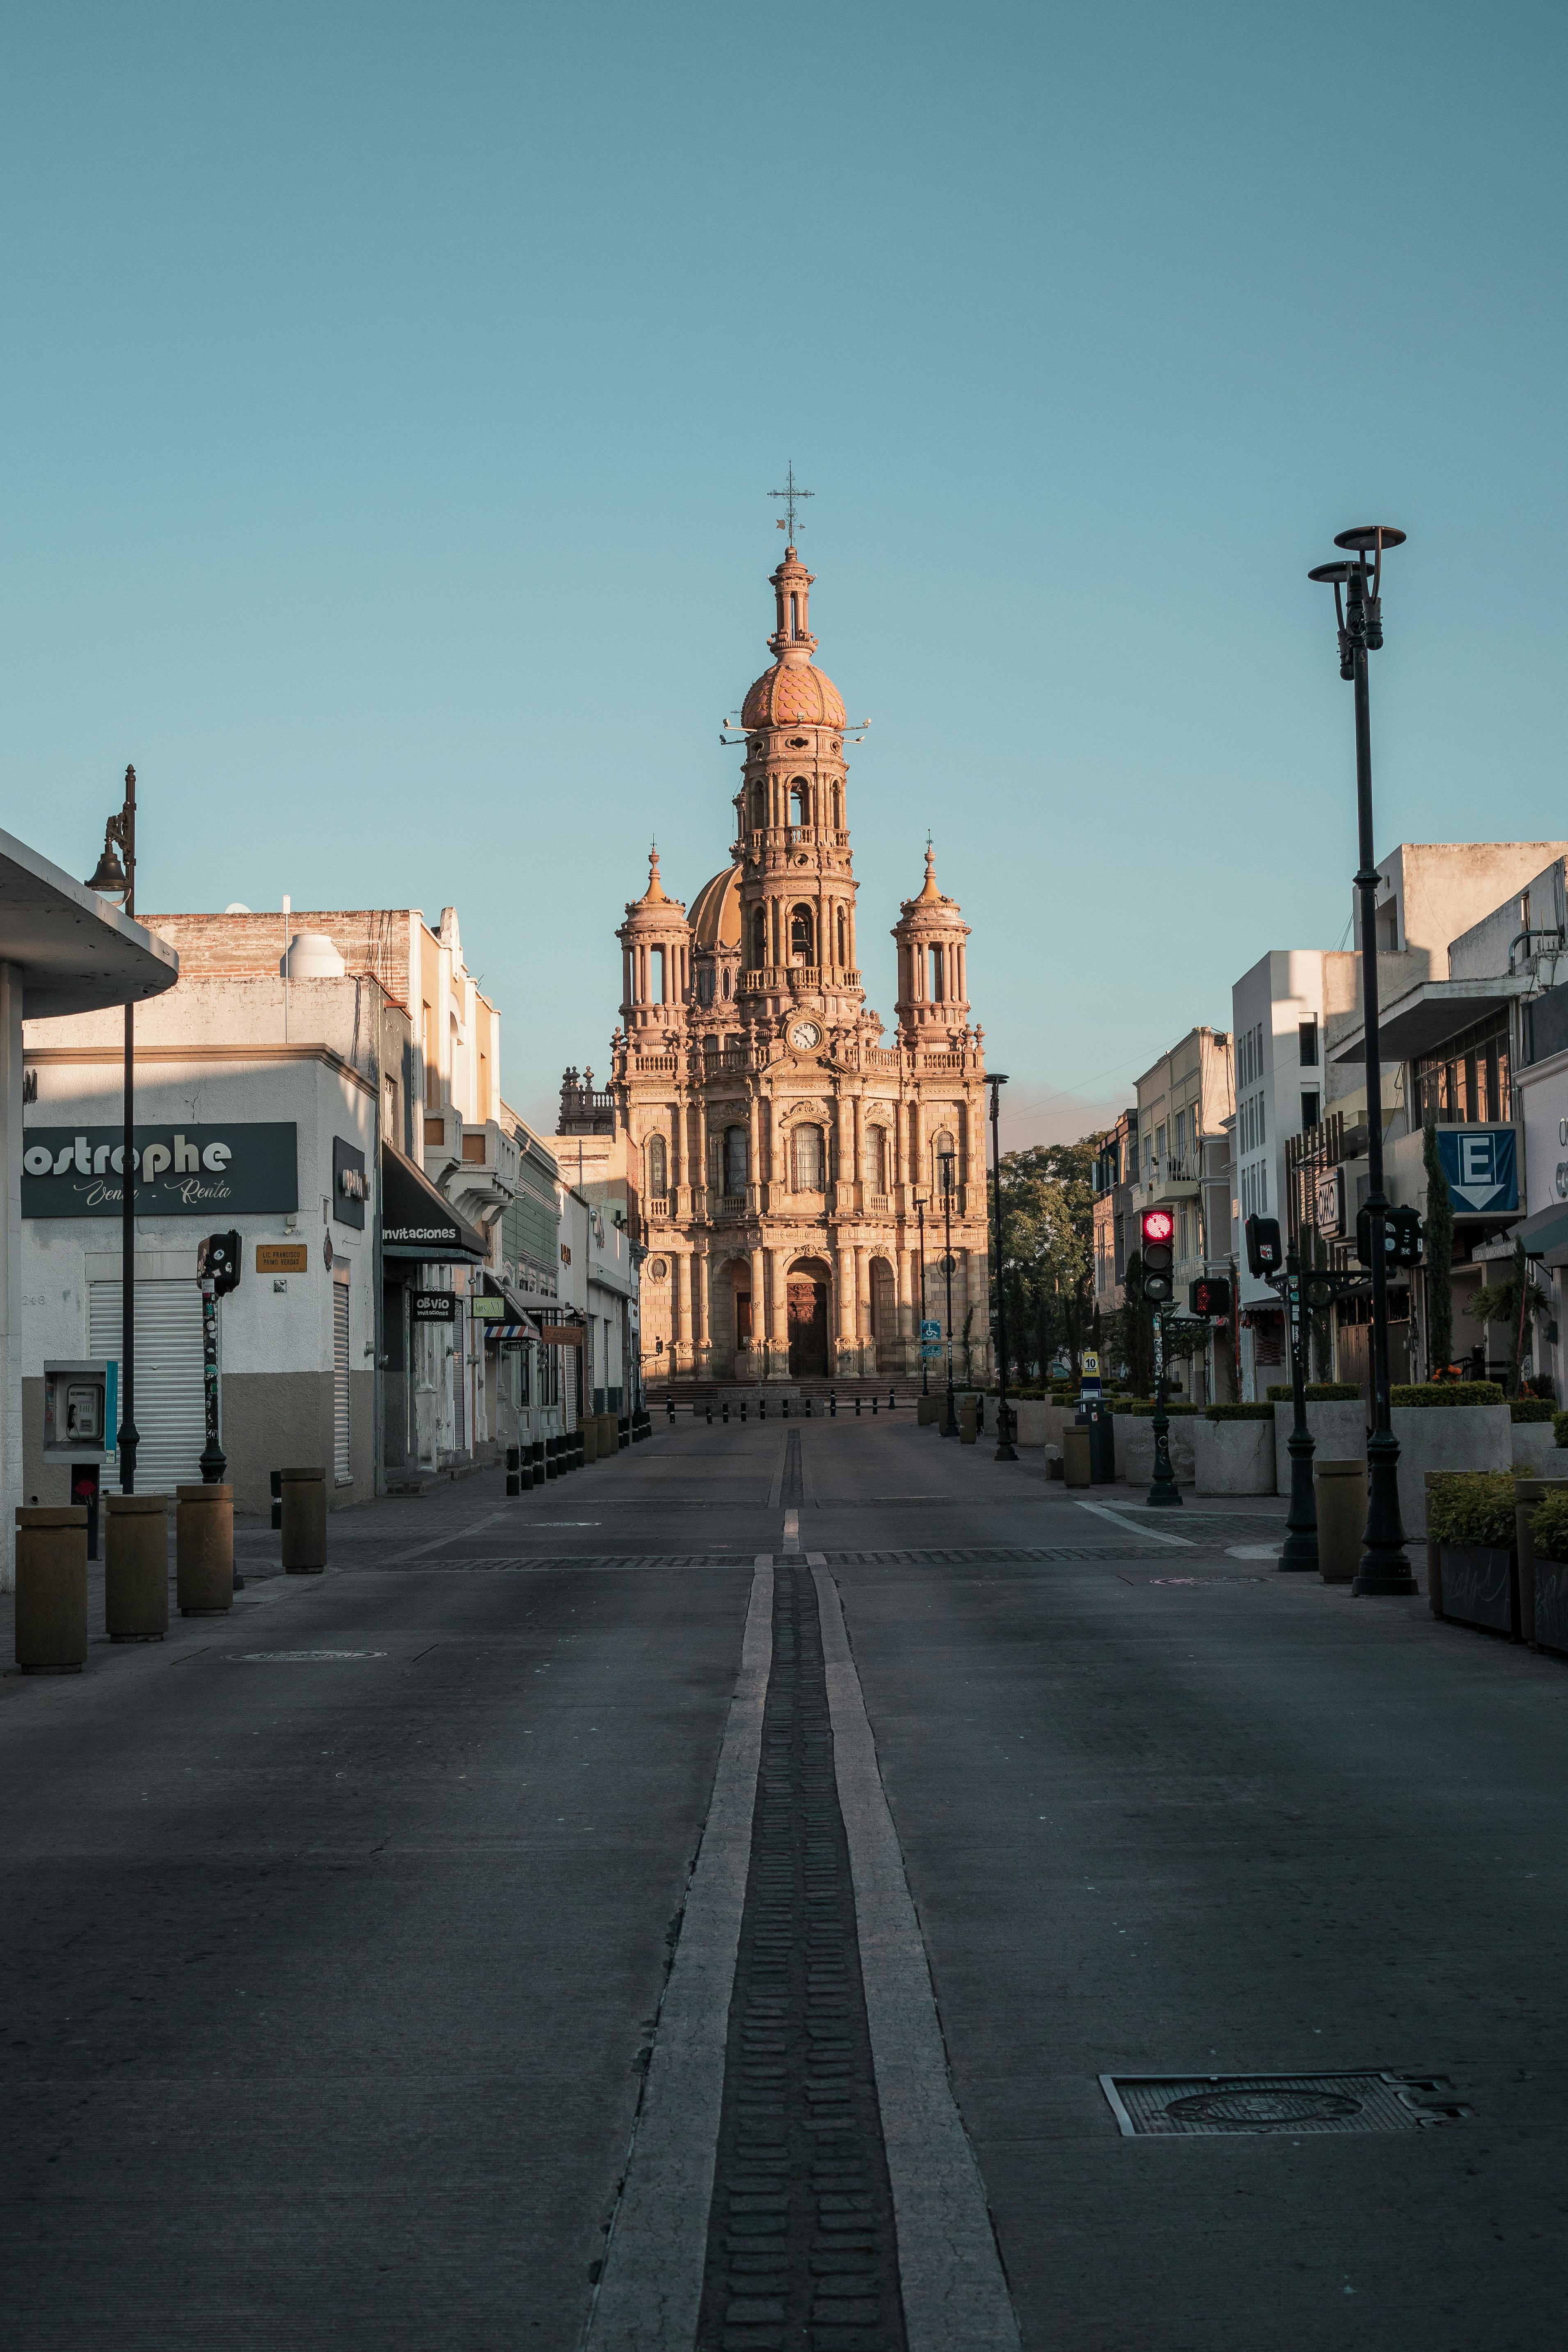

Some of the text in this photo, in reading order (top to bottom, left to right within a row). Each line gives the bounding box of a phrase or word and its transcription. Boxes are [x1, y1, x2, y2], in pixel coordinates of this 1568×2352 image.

[1463, 1137, 1491, 1183] E
[73, 1180, 140, 1206] Ven
[164, 1178, 231, 1204] Renta
[1318, 1183, 1335, 1224] OXXO
[382, 1228, 456, 1240] Invitaciones
[489, 1301, 504, 1314] XV
[1085, 1358, 1096, 1368] 10
